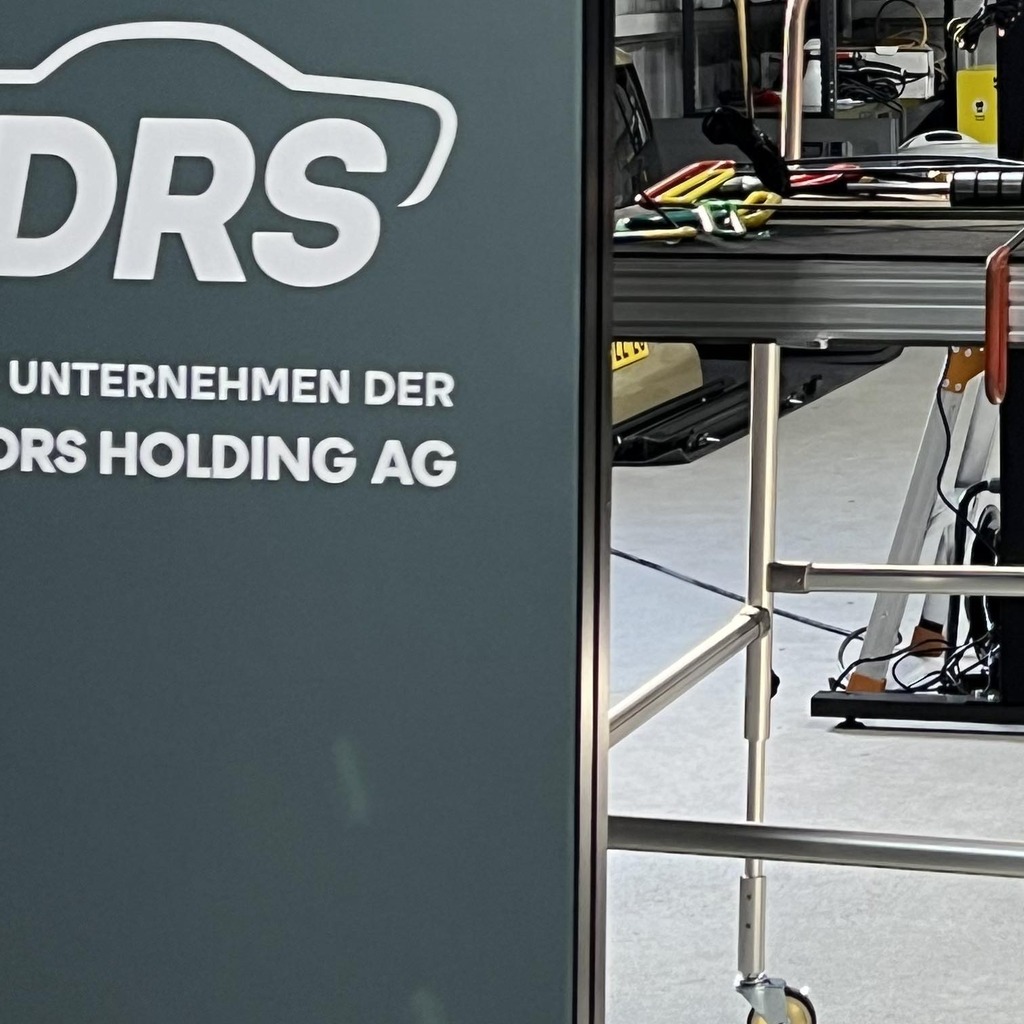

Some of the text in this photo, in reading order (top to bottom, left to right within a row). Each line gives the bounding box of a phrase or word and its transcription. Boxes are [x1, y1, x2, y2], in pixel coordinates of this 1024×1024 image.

[0, 115, 388, 287] DRS
[9, 360, 455, 407] UNTERNEHMEN DER
[99, 431, 357, 483] HOLDING
[371, 440, 457, 487] AG
